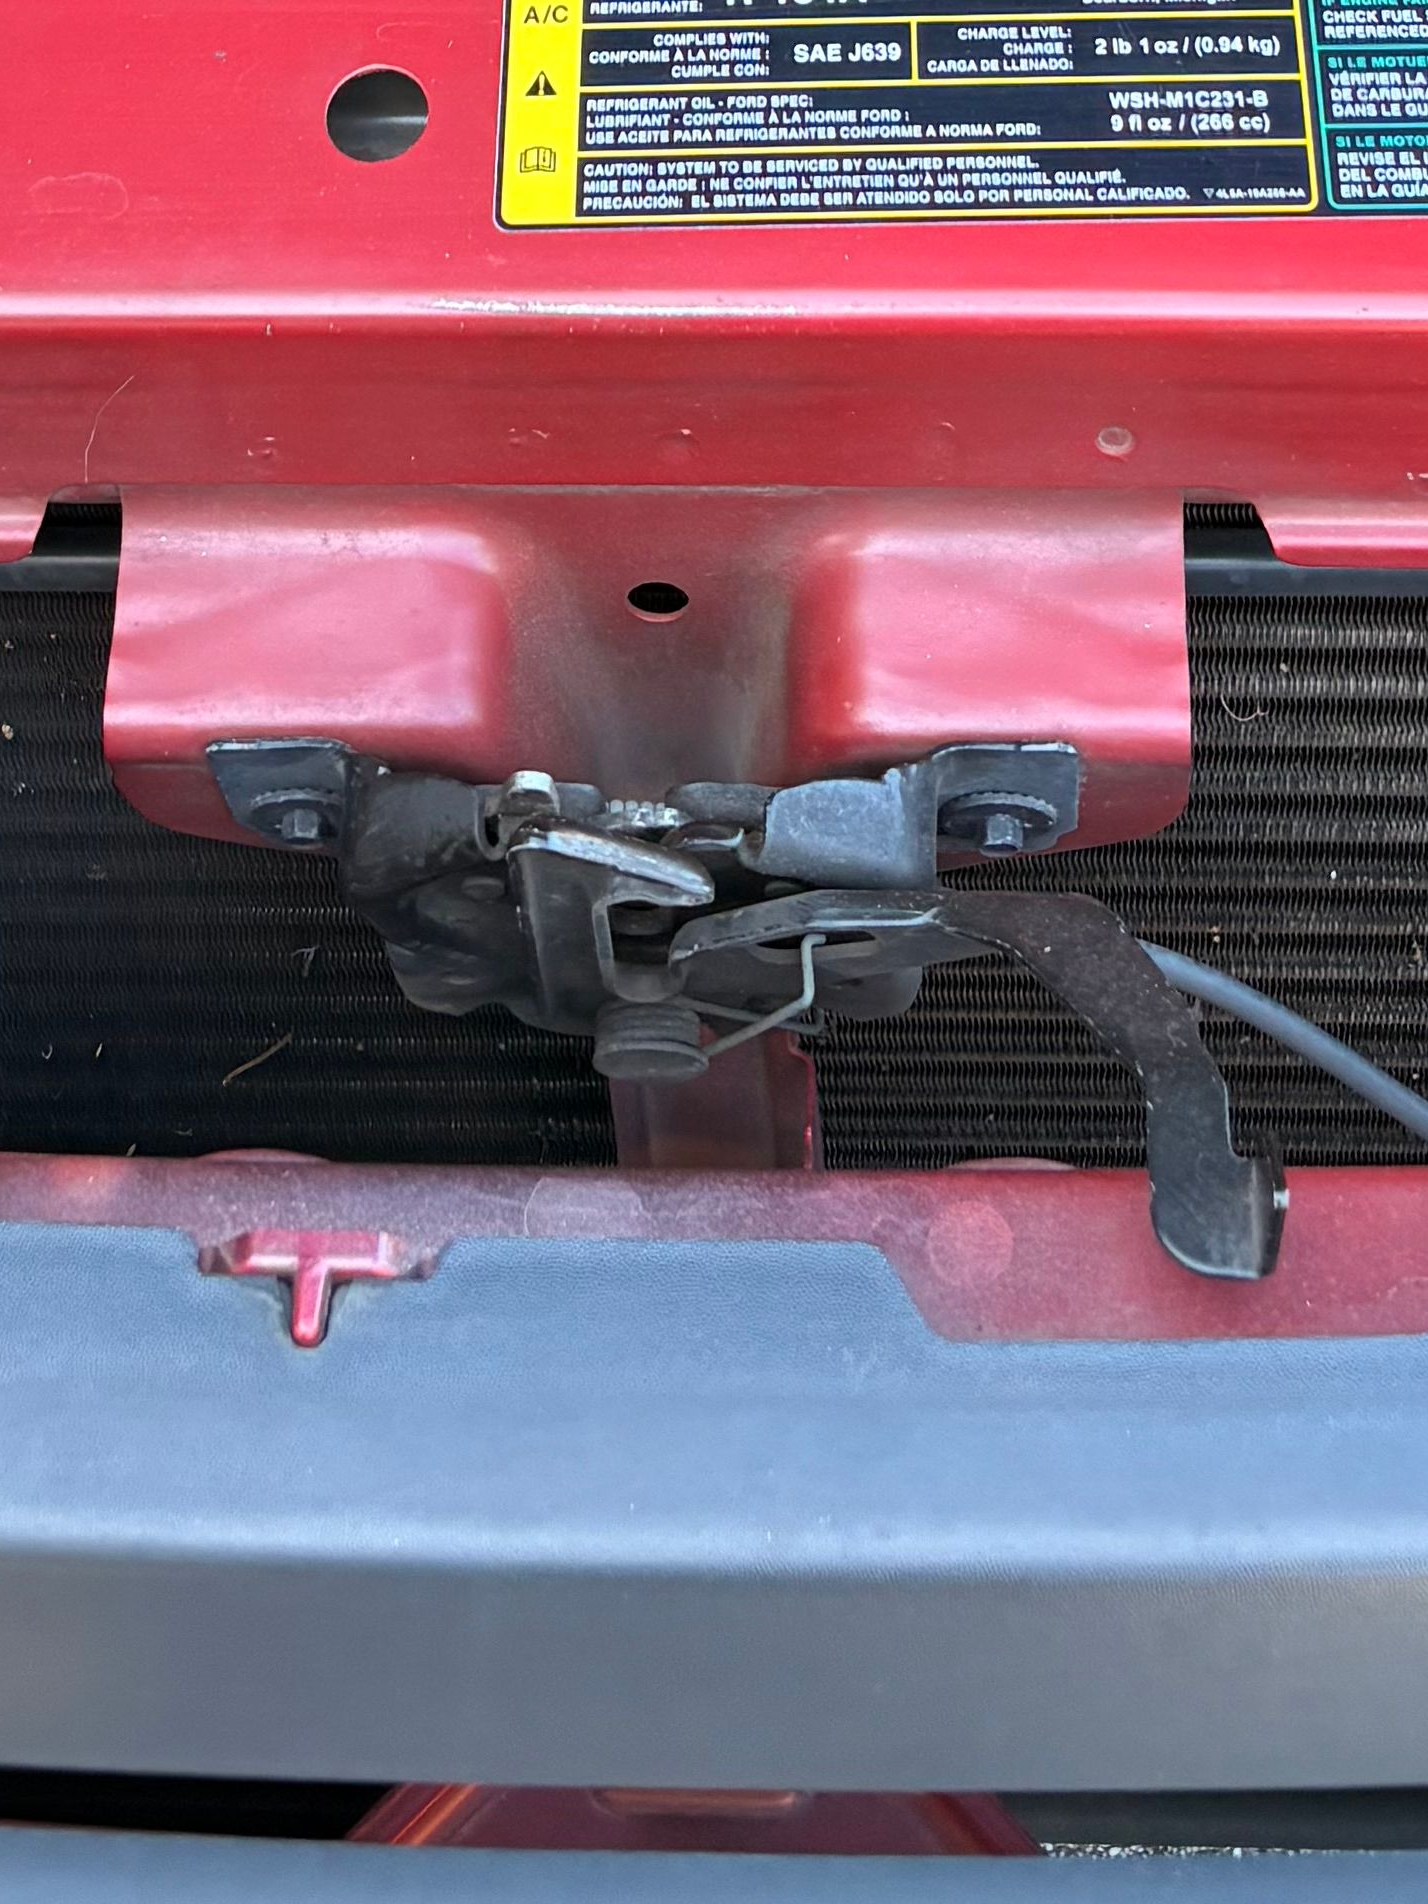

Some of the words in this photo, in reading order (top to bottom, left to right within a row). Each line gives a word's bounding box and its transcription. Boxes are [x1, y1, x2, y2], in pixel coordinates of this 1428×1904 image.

[524, 5, 568, 23] A/C
[590, 0, 703, 14] REFRIGERANTE:
[1323, 11, 1378, 23] CHECK
[1382, 10, 1422, 22] FUEL
[654, 34, 726, 46] COMPLIES
[729, 32, 769, 45] WITH:
[957, 27, 1018, 40] CHARGE
[1022, 27, 1071, 39] LEVEL:
[794, 45, 842, 63] SAE
[849, 43, 901, 62] J639
[1003, 43, 1064, 55] CHARGE
[1095, 39, 1108, 55] 2
[1111, 38, 1133, 55] lb
[1139, 39, 1150, 54] 1
[1154, 41, 1178, 54] oz
[1195, 37, 1243, 57] (0.94
[1249, 36, 1281, 57] kg)
[672, 65, 731, 78] CUMPLE
[735, 64, 769, 77] CON:
[927, 59, 977, 72] CARGA
[981, 59, 999, 71] DE
[1003, 58, 1073, 71] LLENADO:
[1109, 90, 1268, 110] WSH-M1C231-B
[1111, 115, 1123, 132] 9
[1129, 115, 1142, 131] fl
[1148, 117, 1171, 131] oz
[1191, 114, 1234, 135] (266
[1239, 113, 1270, 133] cc)
